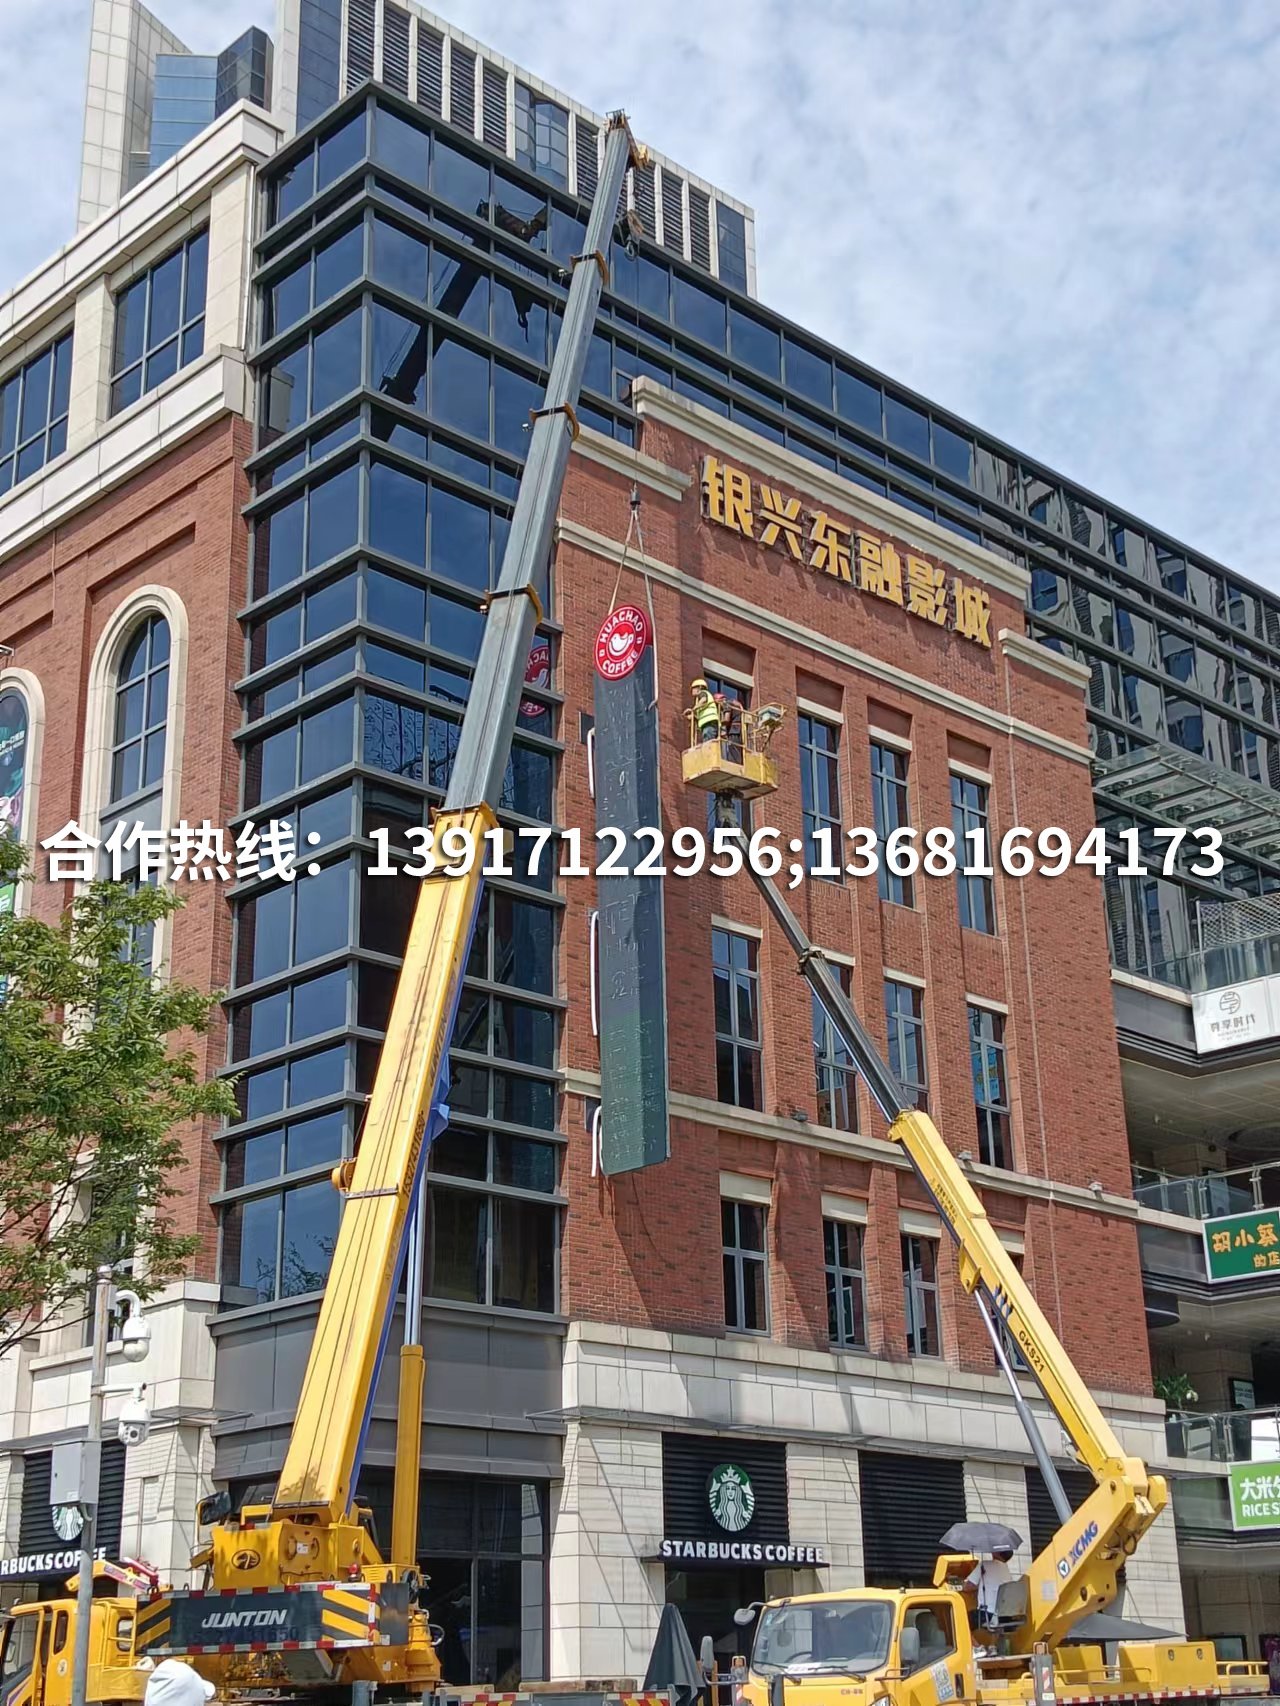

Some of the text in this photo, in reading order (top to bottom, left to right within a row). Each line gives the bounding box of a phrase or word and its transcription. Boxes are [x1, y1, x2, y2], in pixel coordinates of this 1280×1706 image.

[701, 454, 992, 649] 银兴东融影城
[599, 610, 643, 643] HUACHAO
[602, 650, 638, 674] COFFEE
[1018, 1329, 1046, 1374] GKS21
[1242, 1503, 1271, 1517] RICE
[662, 1540, 824, 1562] STARBUCKS COFFEE
[1069, 1520, 1098, 1566] XCMG
[54, 1546, 107, 1569] COFE
[202, 1609, 288, 1628] JUNTON
